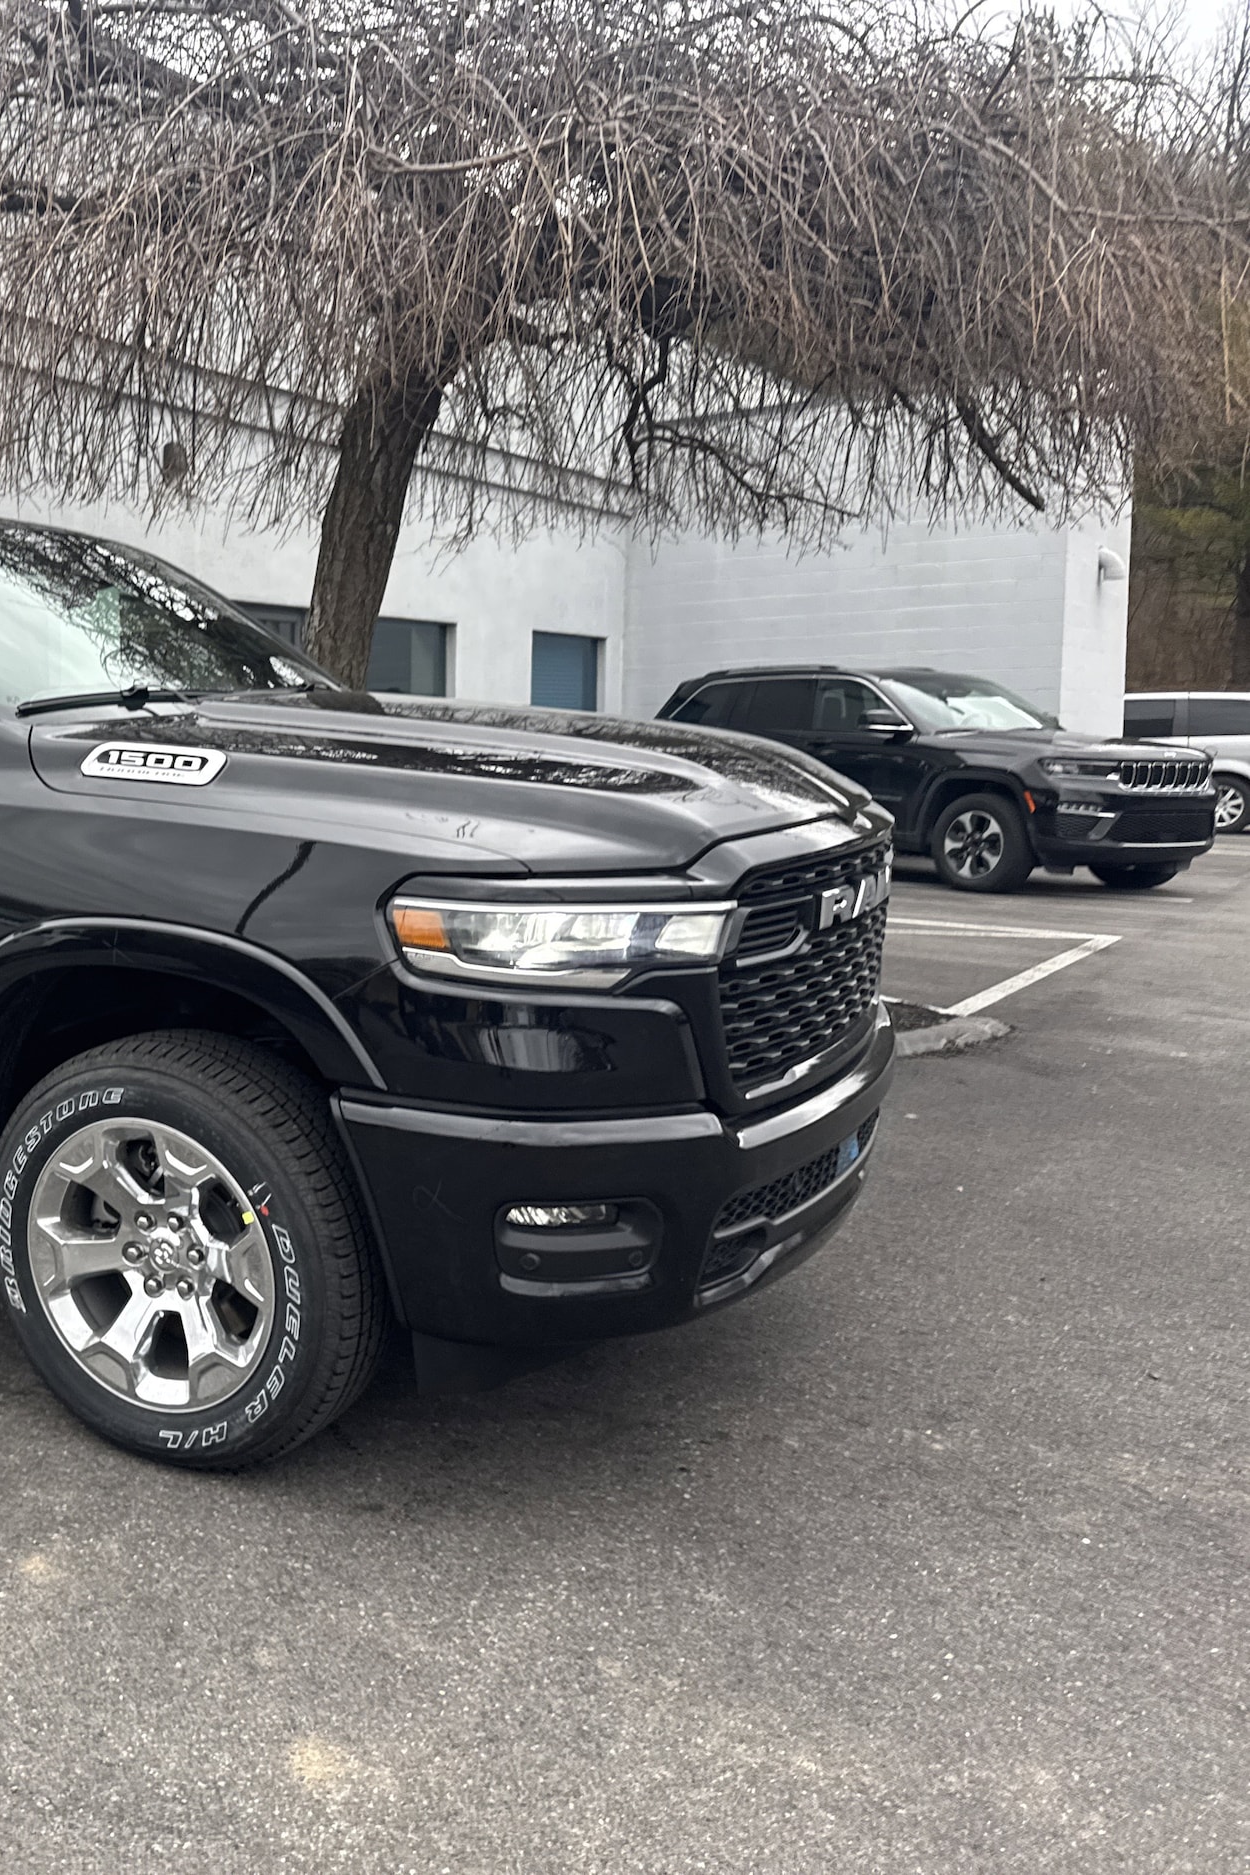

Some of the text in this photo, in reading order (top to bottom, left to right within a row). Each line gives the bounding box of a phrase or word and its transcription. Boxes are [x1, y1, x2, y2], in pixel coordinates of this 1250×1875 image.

[107, 750, 202, 771] 1500
[159, 1223, 301, 1449] DUELER H/L
